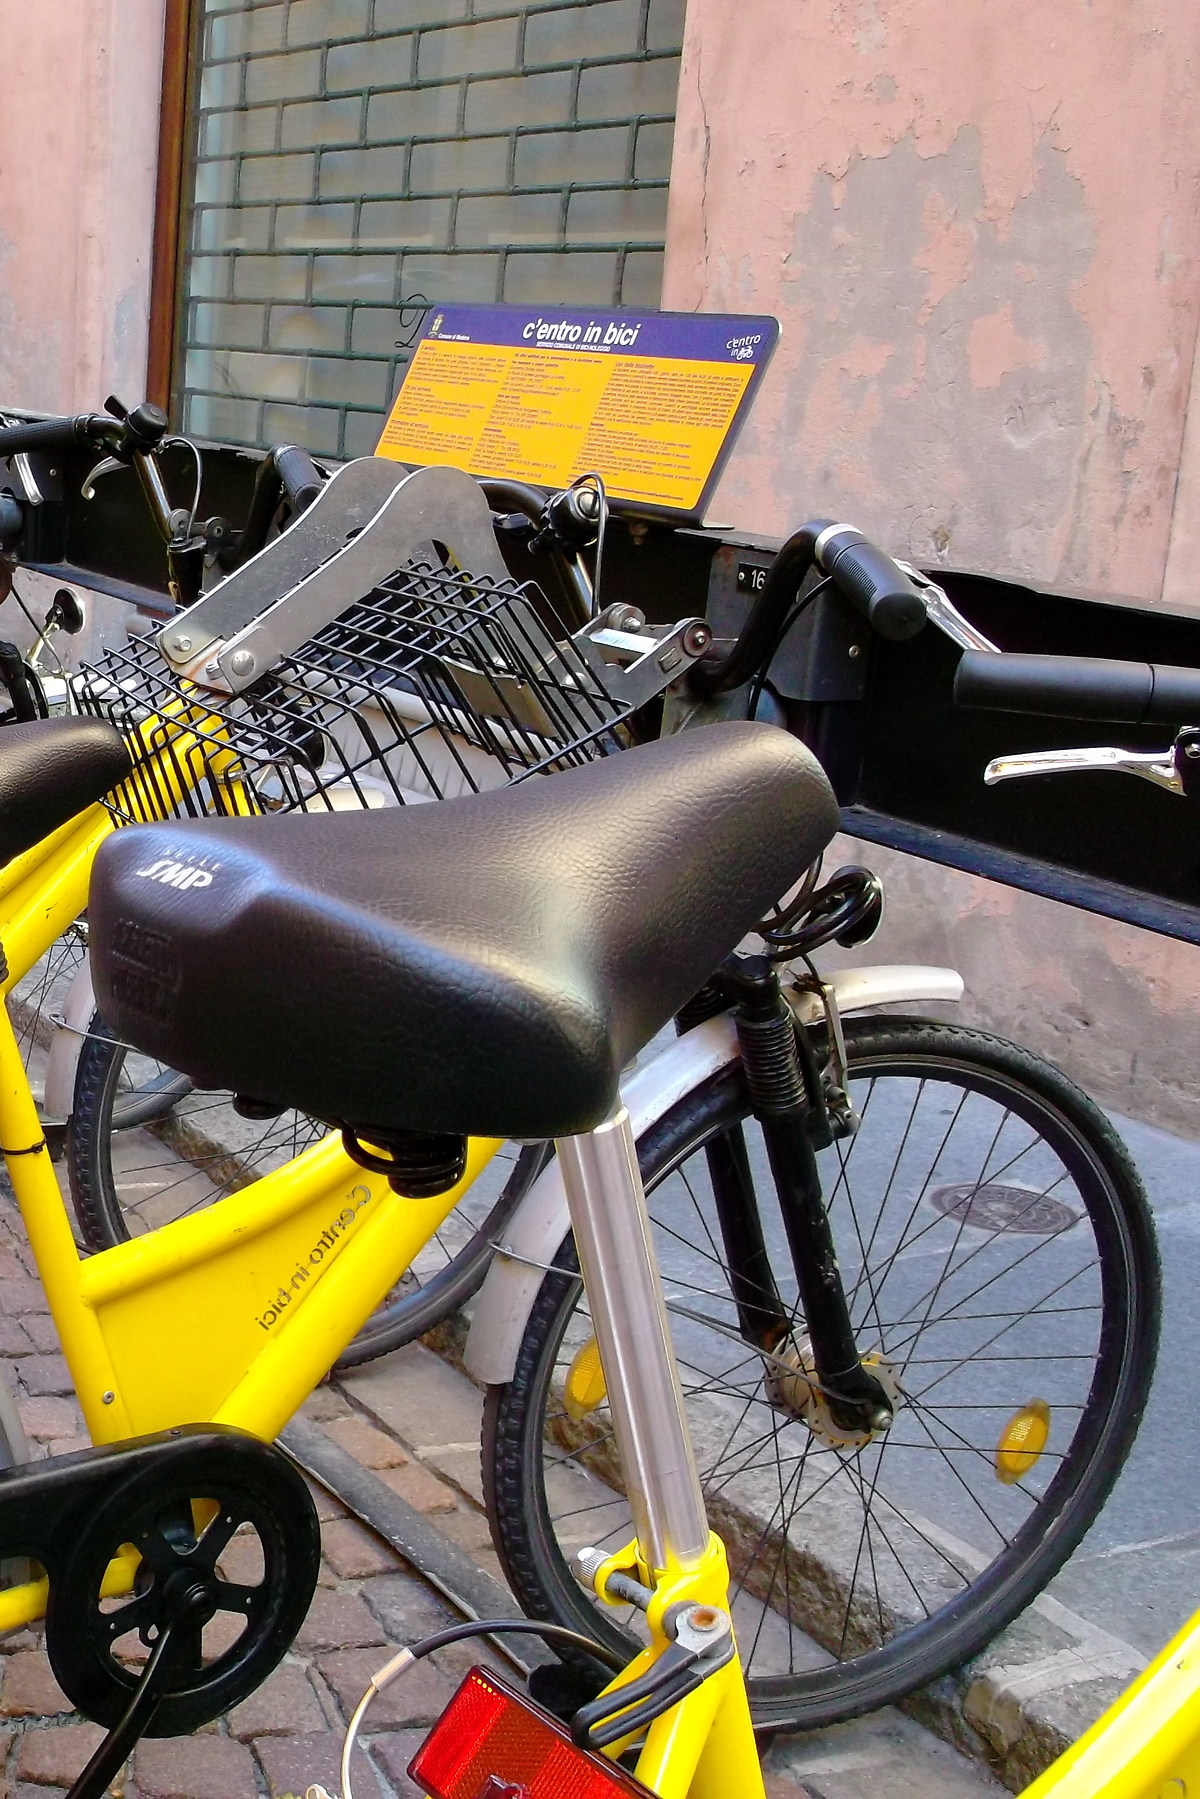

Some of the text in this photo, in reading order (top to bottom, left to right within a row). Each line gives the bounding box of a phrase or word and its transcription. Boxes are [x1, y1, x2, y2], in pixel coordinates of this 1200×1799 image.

[522, 318, 642, 346] c'entro in bici
[730, 348, 739, 357] in
[164, 846, 223, 872] SELLE
[135, 859, 214, 891] SMP
